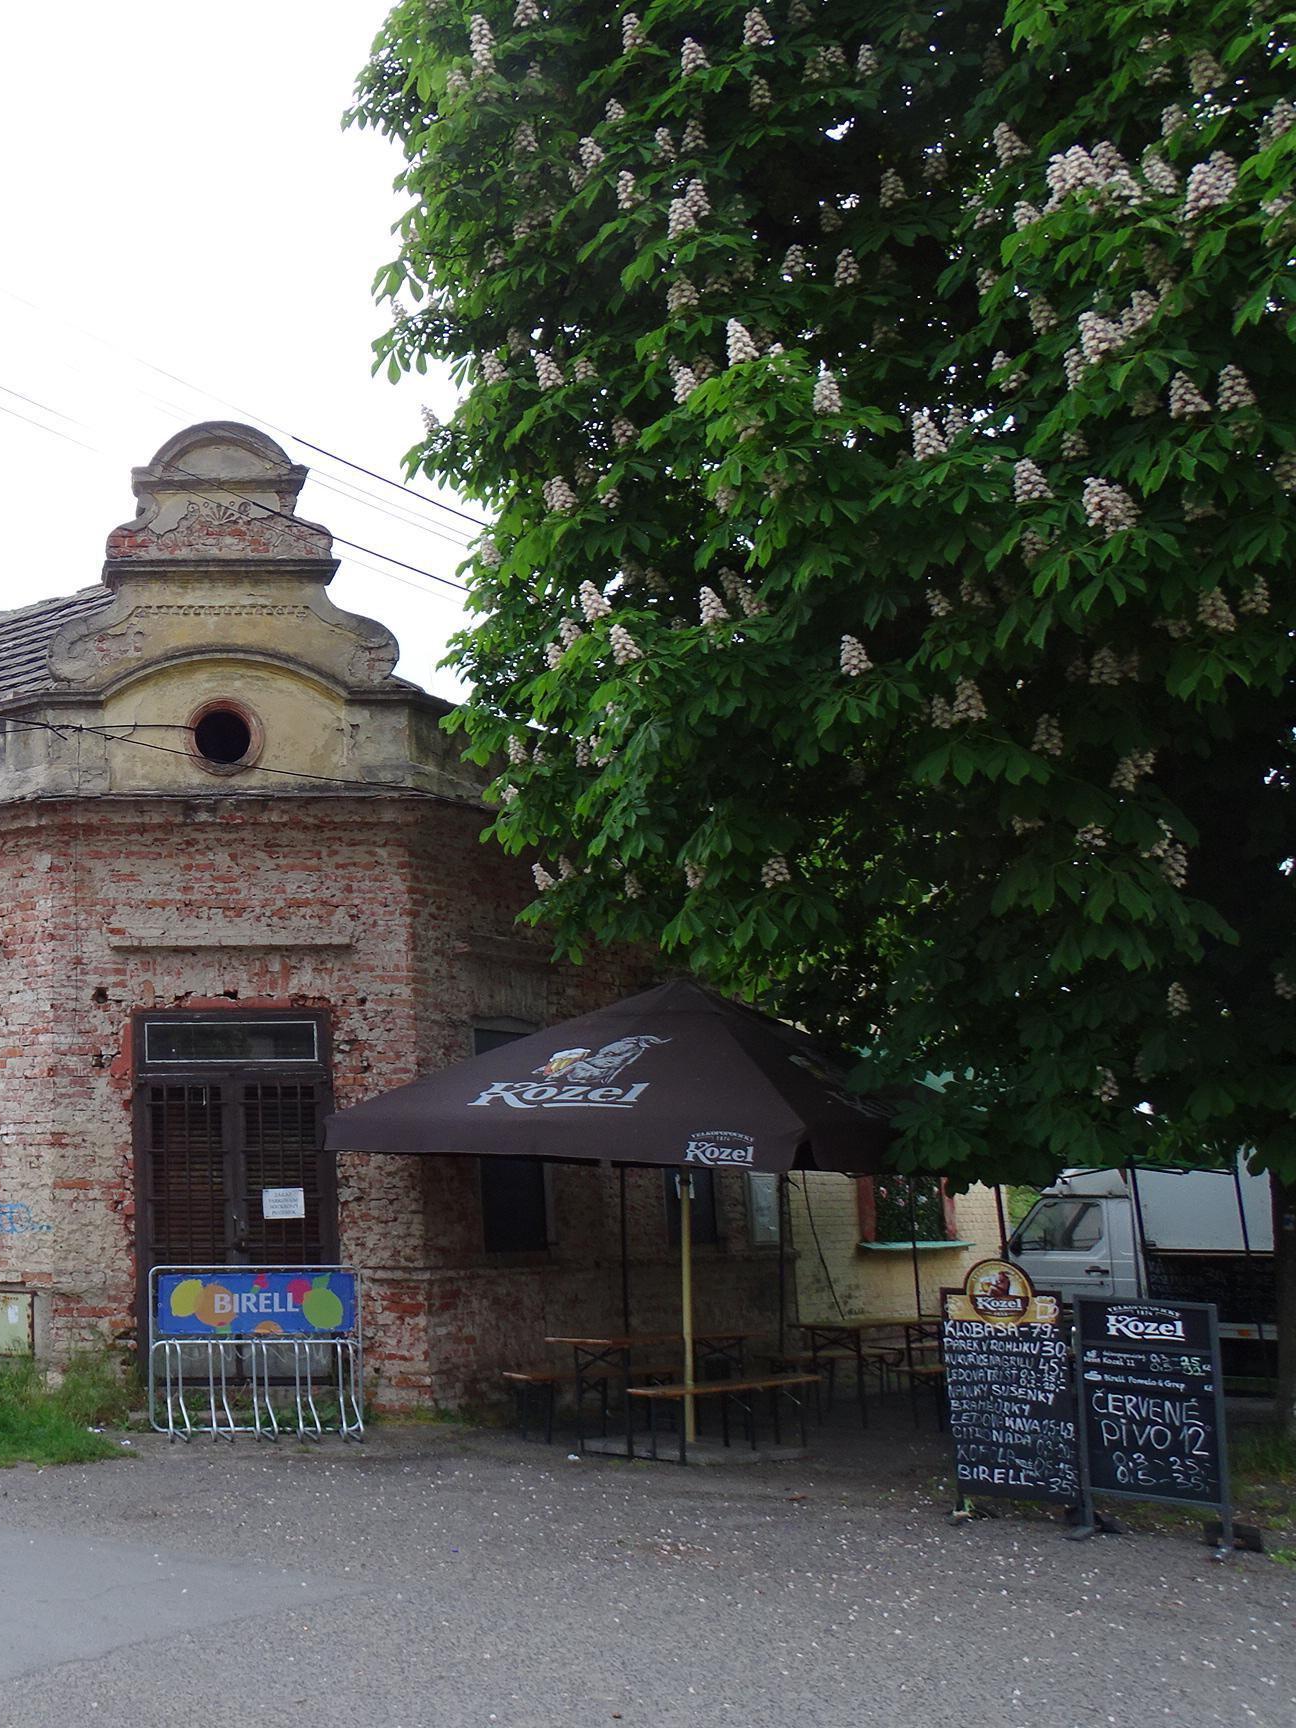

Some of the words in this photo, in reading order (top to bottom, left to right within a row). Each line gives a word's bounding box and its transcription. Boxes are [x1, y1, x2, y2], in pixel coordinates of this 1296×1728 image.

[467, 1082, 650, 1108] Kozel
[685, 1141, 754, 1167] Kozel
[214, 1292, 300, 1314] BIRELL
[975, 1297, 1023, 1311] Kozel
[1105, 1314, 1186, 1341] Kozel
[1092, 1388, 1204, 1426] ČERVENÉ
[958, 1463, 1034, 1486] BIRELL
